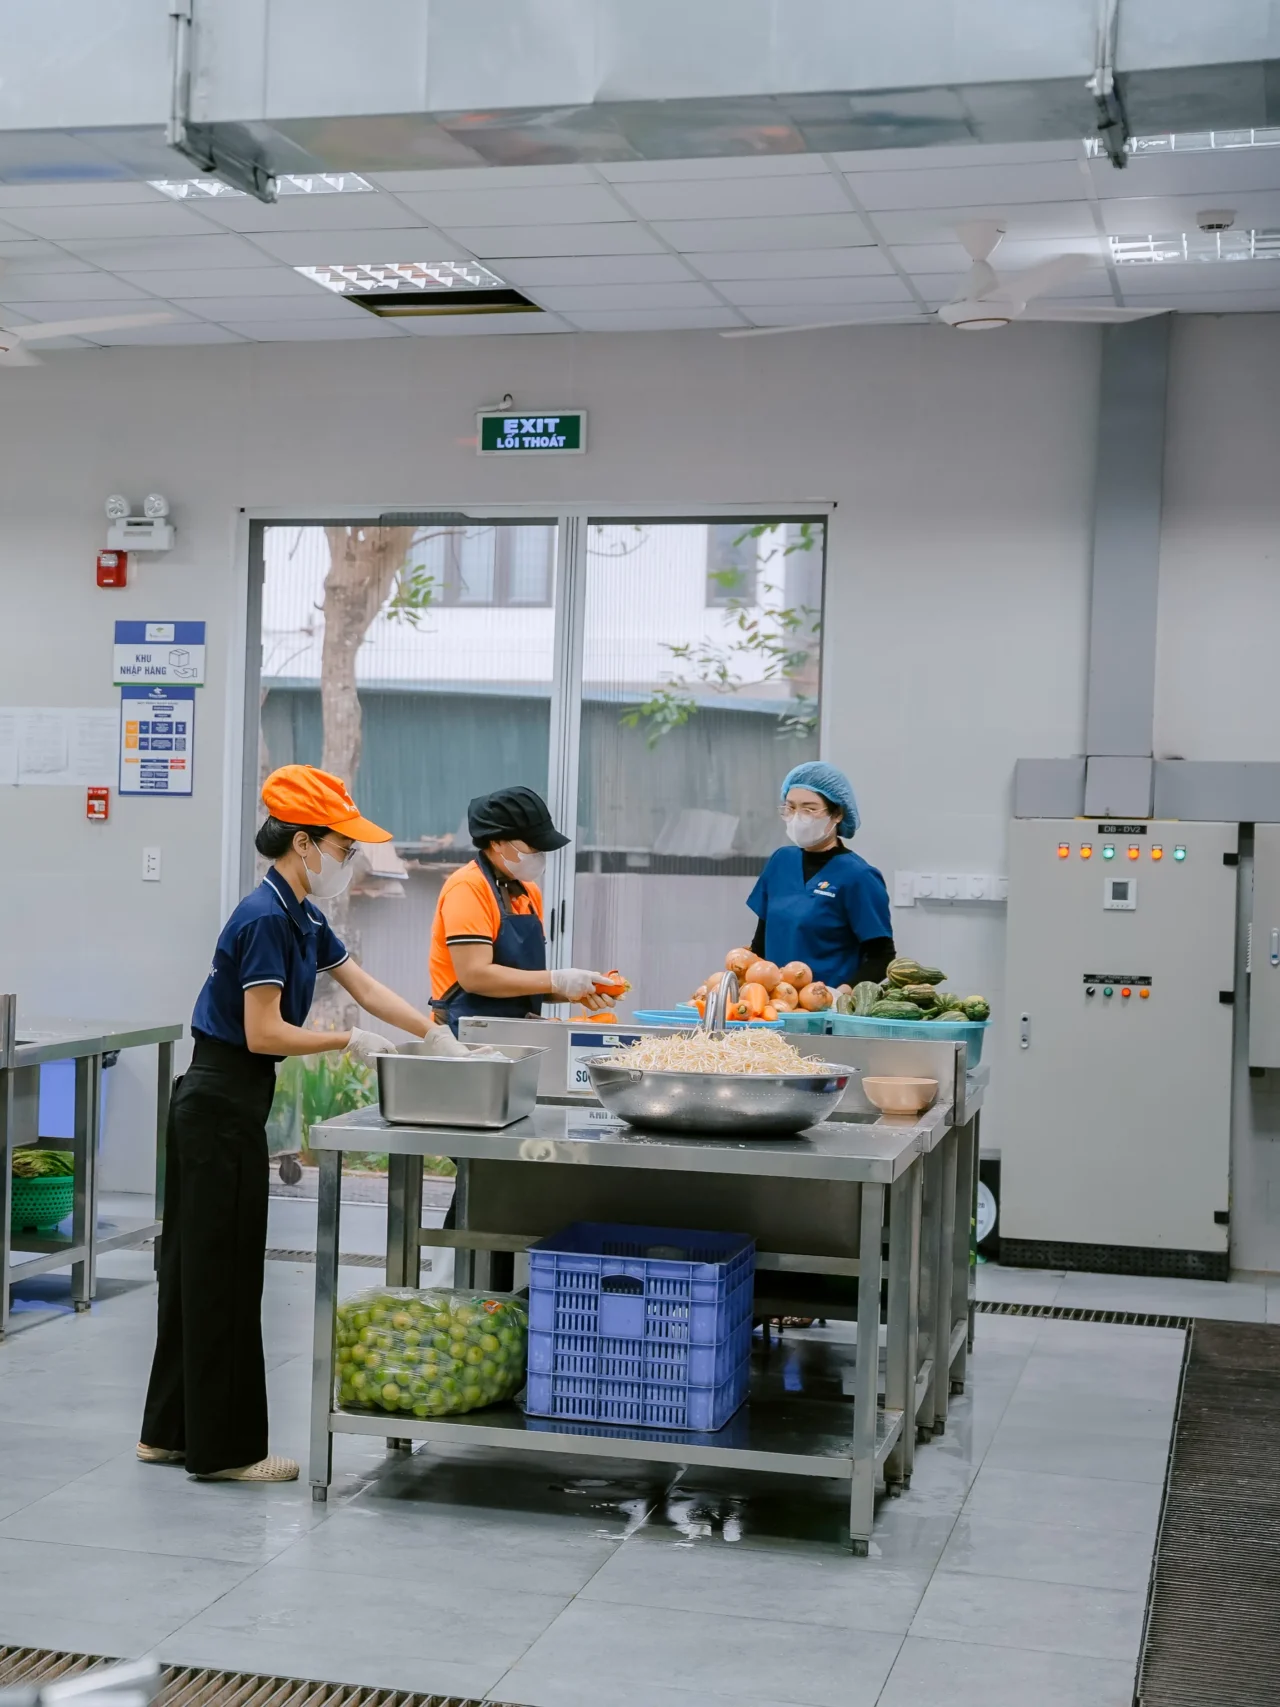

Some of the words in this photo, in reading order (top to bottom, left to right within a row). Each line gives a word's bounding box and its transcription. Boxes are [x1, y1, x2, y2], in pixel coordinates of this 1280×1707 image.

[503, 418, 560, 434] EXIT
[522, 434, 566, 448] THOÁT
[135, 654, 152, 663] KHU
